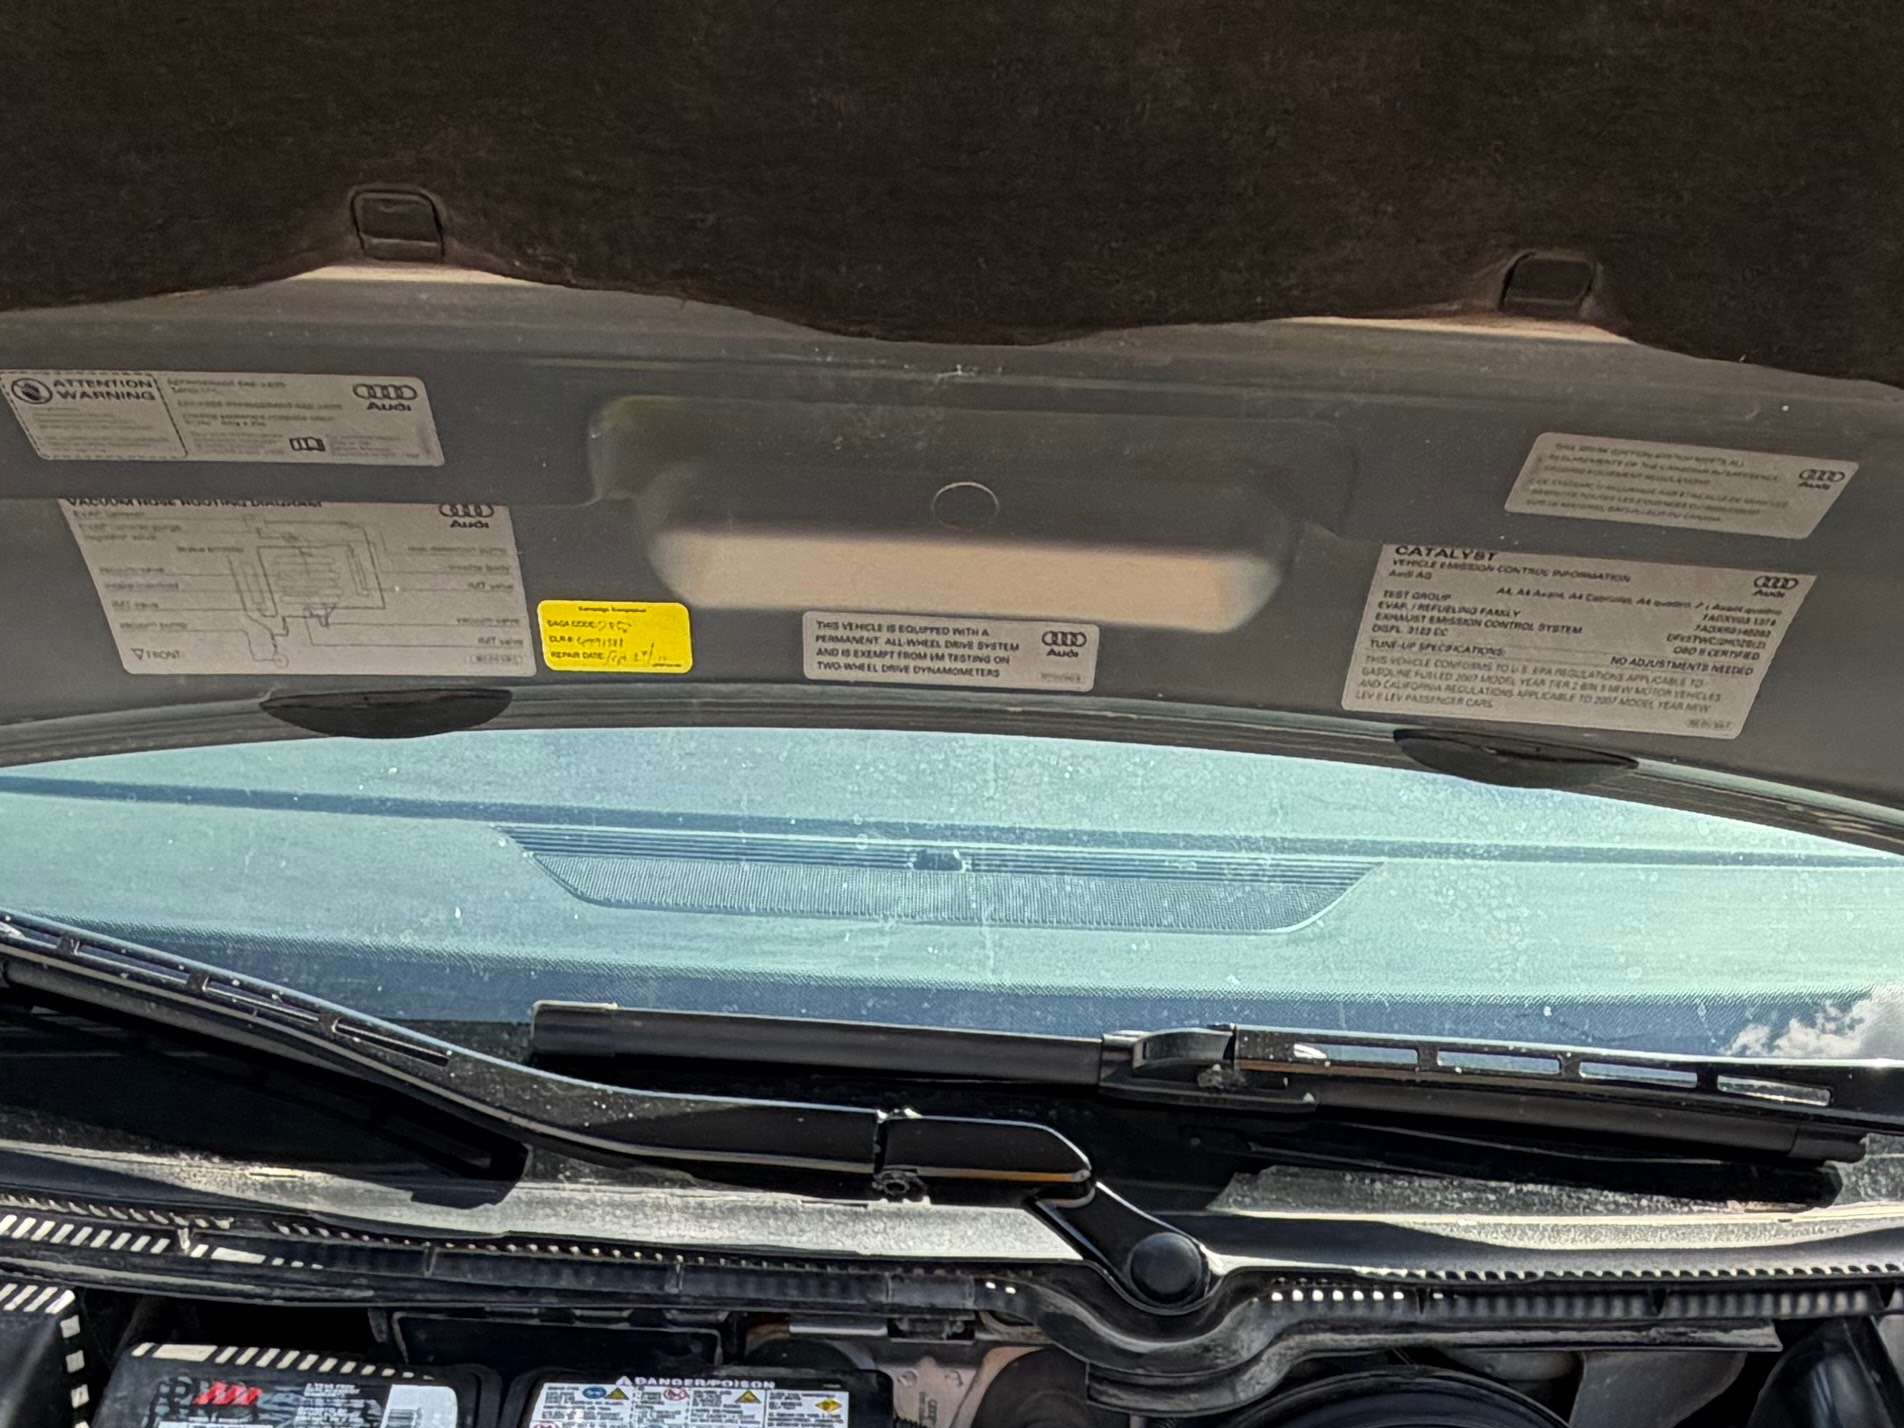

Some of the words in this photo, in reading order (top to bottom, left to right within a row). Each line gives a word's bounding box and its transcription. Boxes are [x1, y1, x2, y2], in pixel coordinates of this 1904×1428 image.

[53, 379, 153, 389] ATTENTION
[57, 390, 156, 401] WARNING
[1395, 545, 1497, 561] CATALYST
[1393, 559, 1436, 568] VEHICLE
[1440, 561, 1494, 572] EMISSION
[1497, 565, 1548, 577] CONTROL
[1552, 569, 1631, 583] INFORMATION
[1383, 590, 1410, 599] TEST
[1412, 590, 1452, 601] GROUP
[1417, 602, 1478, 615] REFUELING
[1480, 607, 1521, 618] FAMILY
[816, 620, 839, 630] THIS
[842, 622, 882, 632] VEHICLE
[887, 624, 896, 633] IS
[898, 624, 950, 635] EQUIPPED
[952, 627, 979, 636] WITH
[981, 628, 990, 637] A
[1376, 612, 1426, 624] EXHAUST
[1429, 615, 1481, 627] EMISSION
[1484, 620, 1534, 632] CONTROL
[1538, 622, 1583, 634] SYSTEM
[816, 634, 880, 645] PERMANENT
[944, 640, 974, 650] DRIVE
[977, 641, 1020, 652] SYSTEM
[816, 647, 839, 657] AND
[841, 648, 851, 657] IS
[853, 649, 895, 659] EXEMPT
[897, 651, 927, 661] FROM
[947, 653, 991, 664] TESTING
[993, 655, 1010, 665] ON
[1046, 648, 1079, 657] Audi
[1371, 639, 1416, 650] TUNE-UP
[1610, 656, 1627, 666] NO
[1629, 658, 1709, 672] ADJUSTMENTS
[1711, 664, 1754, 676] NEEDED
[1707, 649, 1760, 661] CERTIFIED
[1366, 655, 1387, 665] THIS
[1390, 656, 1431, 667] VEHICLE
[881, 664, 910, 673] DRIVE
[1359, 679, 1381, 689] AND
[1480, 674, 1516, 686] MODEL
[1520, 678, 1546, 688] YEAR
[634, 1376, 777, 1389] DANGER/POISON
